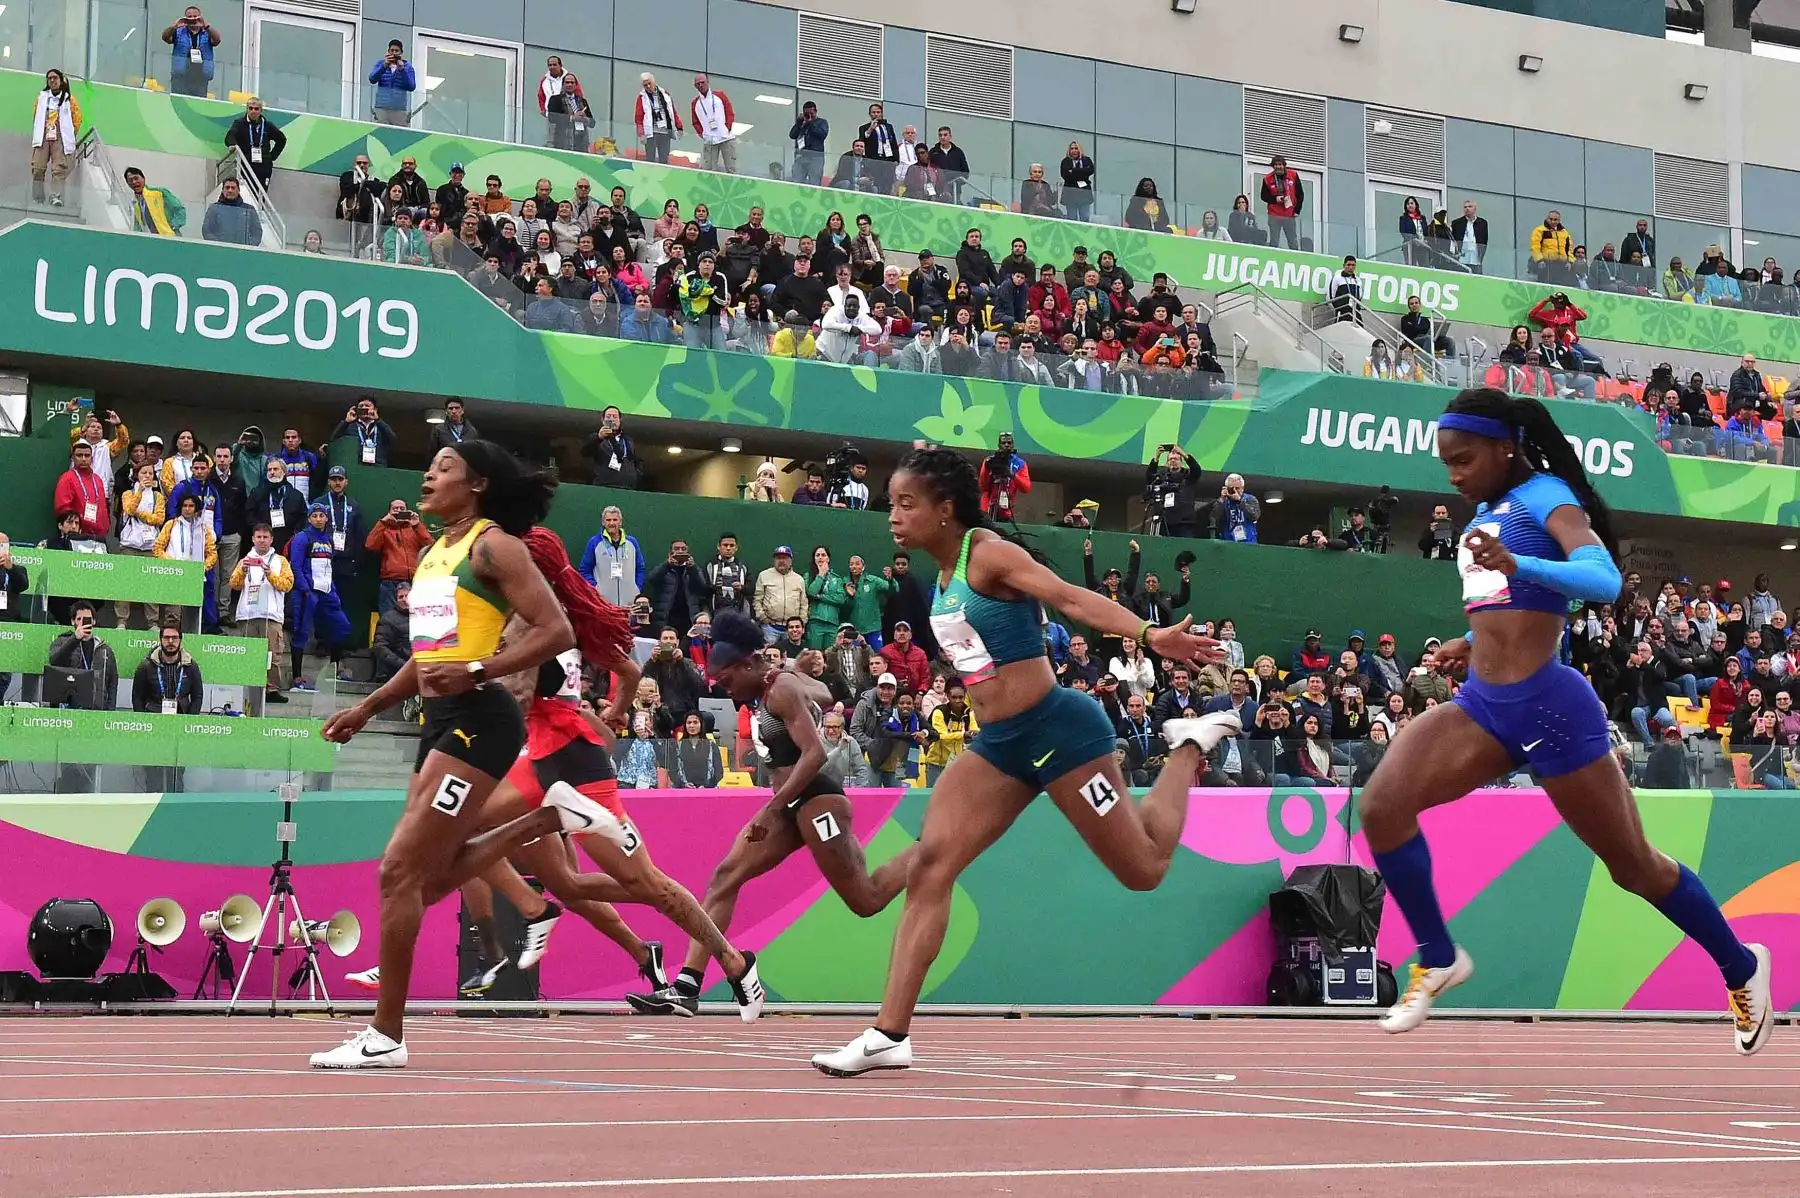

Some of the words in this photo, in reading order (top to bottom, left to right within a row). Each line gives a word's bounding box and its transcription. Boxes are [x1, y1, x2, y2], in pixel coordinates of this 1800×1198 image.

[1202, 253, 1336, 296] JUGAMO
[1360, 272, 1460, 311] TODOS
[1301, 407, 1440, 455] JUGAM
[1564, 434, 1635, 478] DOS
[437, 778, 466, 811] 5
[1089, 783, 1115, 807] 4
[815, 815, 831, 837] 7
